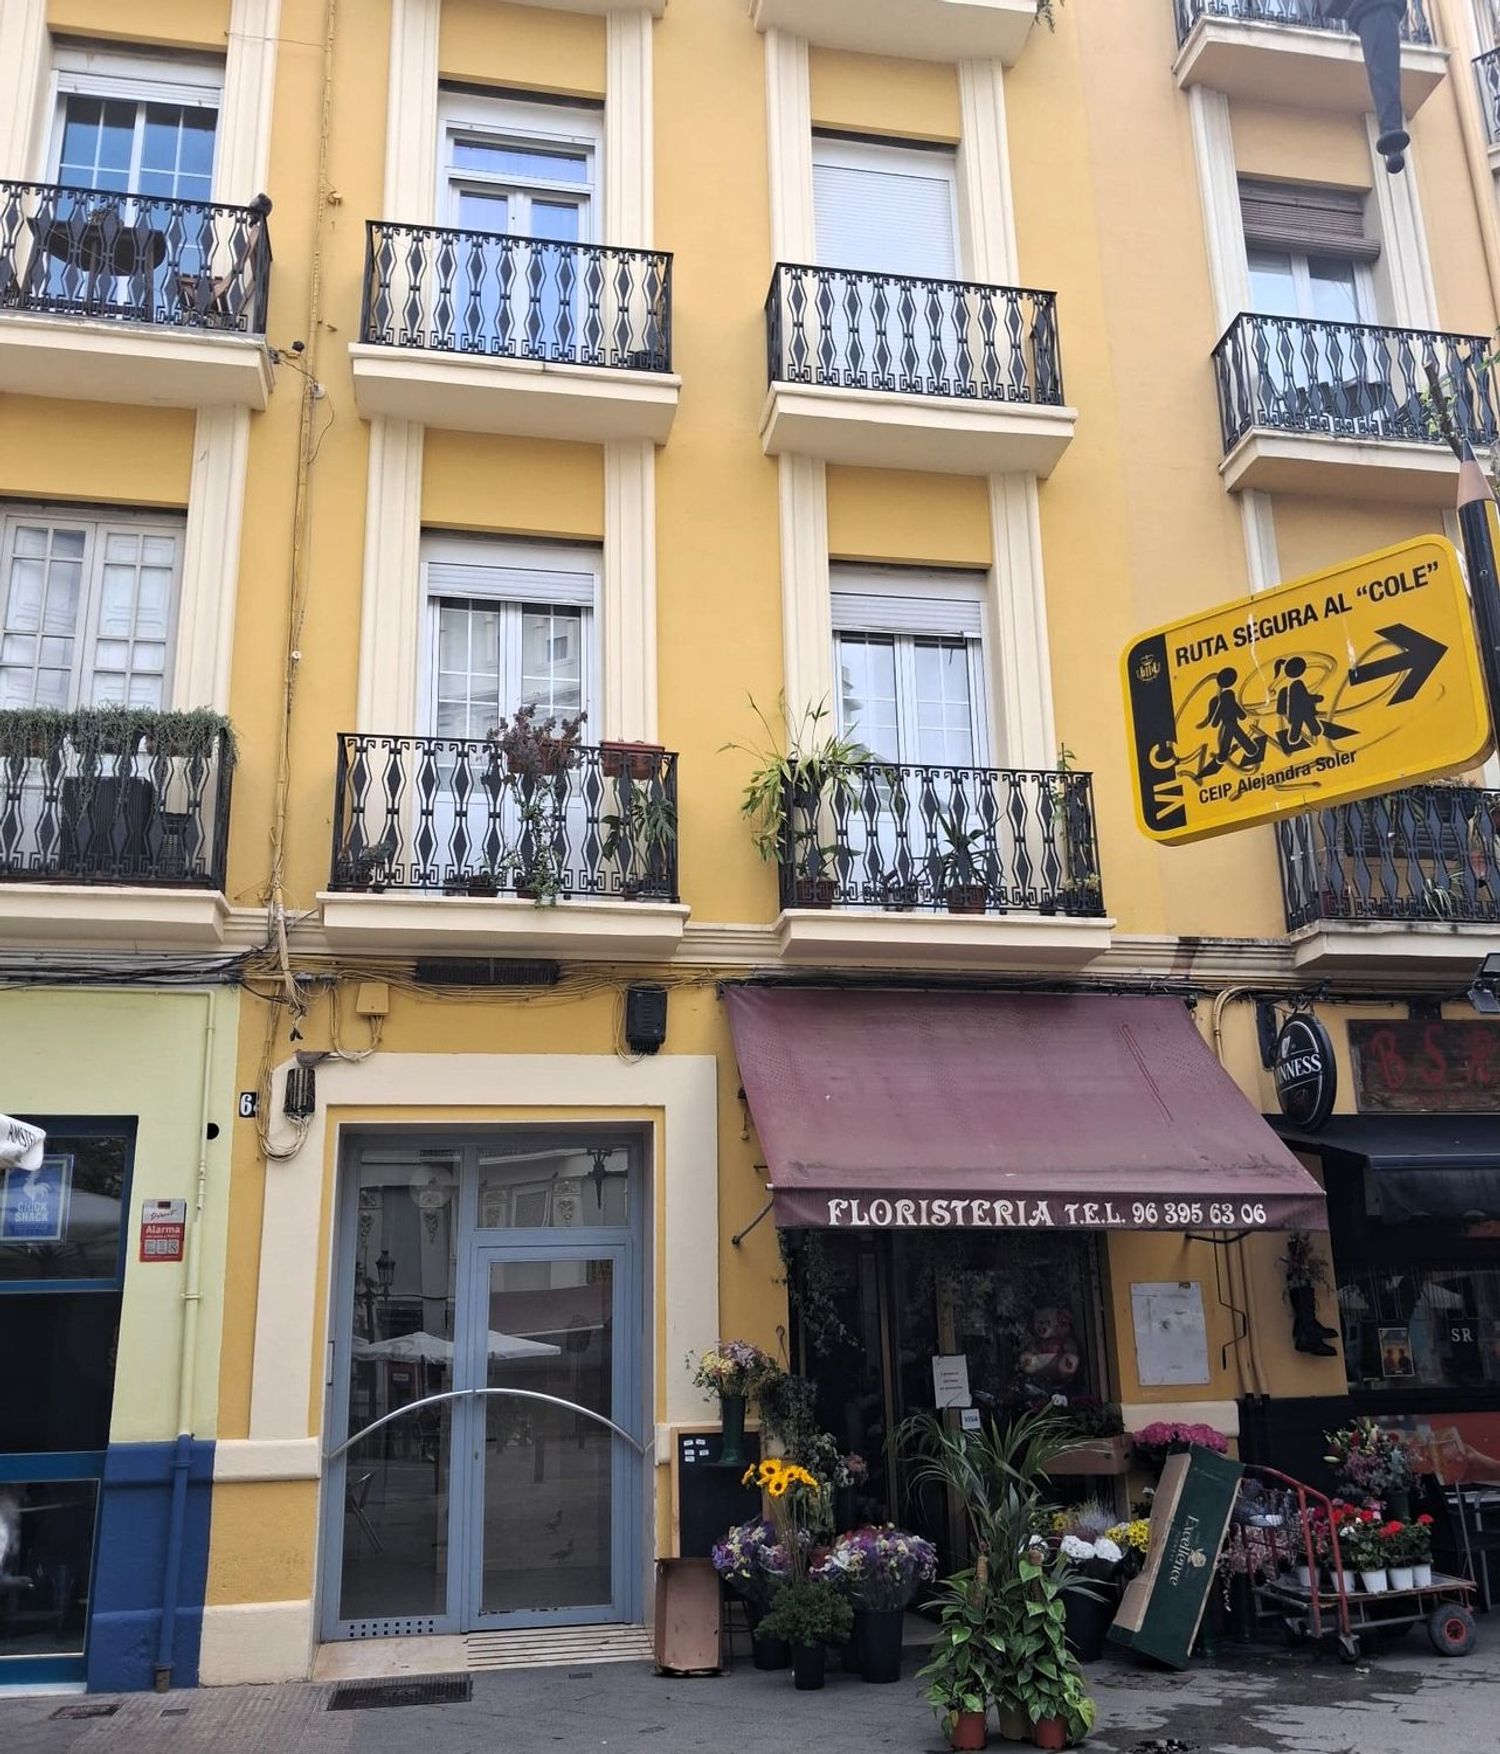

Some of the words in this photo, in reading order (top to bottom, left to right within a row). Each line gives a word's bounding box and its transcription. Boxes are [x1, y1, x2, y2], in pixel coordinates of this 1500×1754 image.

[1175, 634, 1229, 667] RUTA
[1232, 604, 1319, 648] SEGURA
[1324, 593, 1353, 619] AL
[1198, 783, 1233, 804] CEIP
[1237, 764, 1312, 793] Alejandra
[1315, 750, 1357, 772] Soler
[17, 1202, 47, 1212] CHICK
[827, 1199, 1055, 1226] FLORISTERIA
[1131, 1202, 1159, 1224] 96
[1164, 1203, 1204, 1224] 395
[1209, 1203, 1235, 1224] 63
[1240, 1203, 1267, 1224] 06
[15, 1212, 48, 1222] SHACK
[145, 1225, 180, 1234] Alarma
[964, 1415, 979, 1423] VISA
[1169, 1514, 1199, 1586] Excellence
